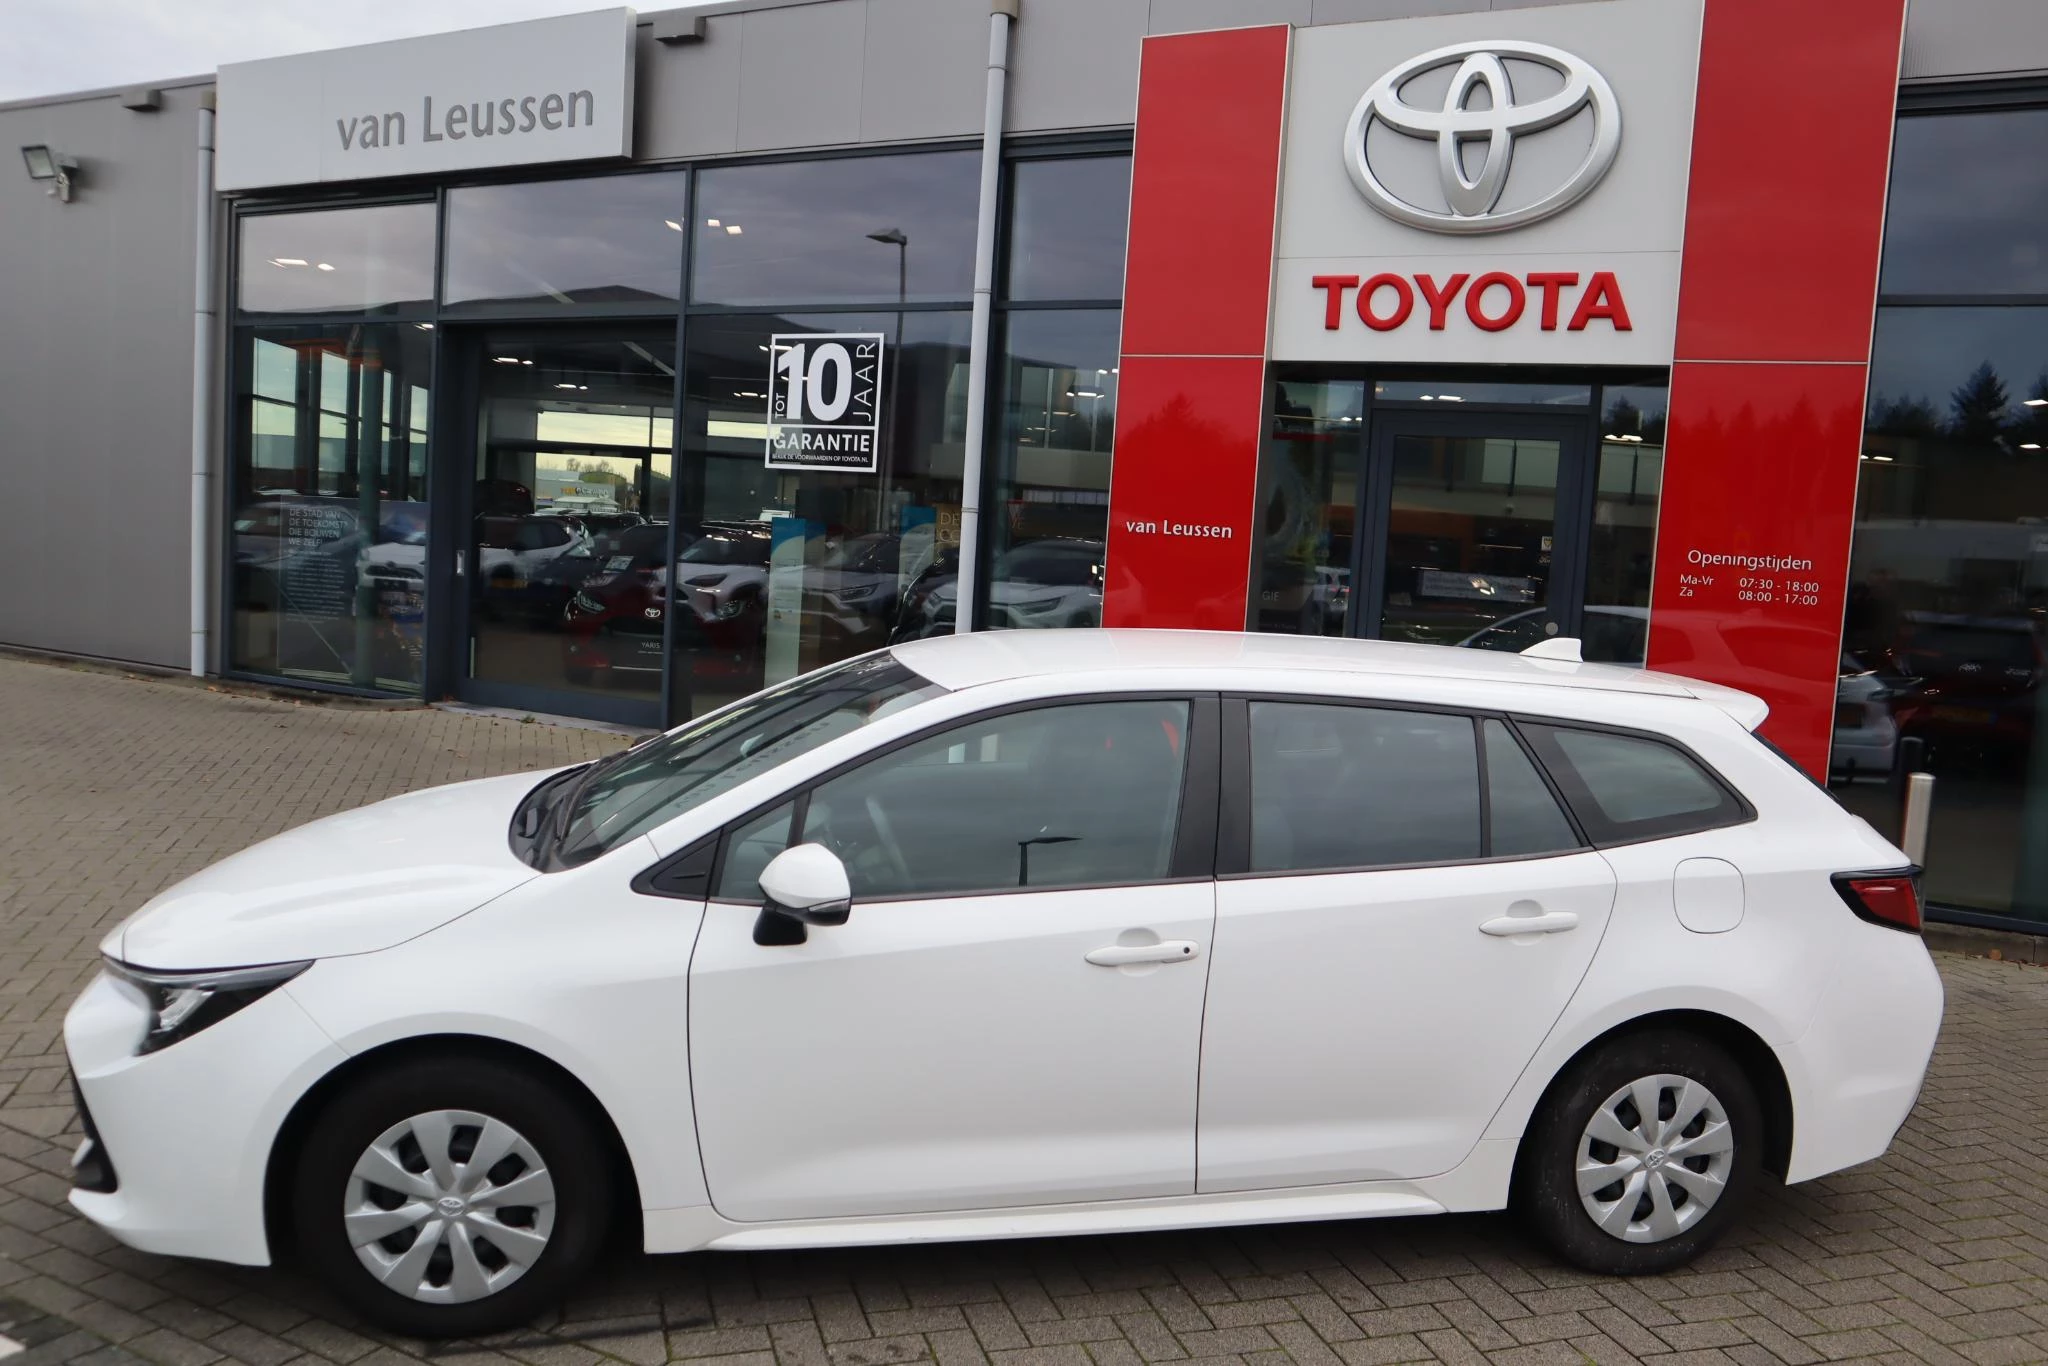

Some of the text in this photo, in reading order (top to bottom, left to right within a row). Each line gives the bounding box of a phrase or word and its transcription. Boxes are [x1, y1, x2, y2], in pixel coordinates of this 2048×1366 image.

[336, 88, 595, 151] van Leussen
[1311, 271, 1633, 332] TOYOTA
[777, 342, 853, 422] 10
[852, 342, 876, 422] JAAR
[774, 392, 786, 420] TOT
[772, 432, 870, 452] GARANTIE
[1126, 519, 1232, 539] van Leussen
[1687, 549, 1813, 572] Openingstijden
[1680, 574, 1714, 586] Ma-Vr
[1739, 577, 1774, 590] 07:30
[1786, 580, 1819, 593] 18:00
[1679, 587, 1693, 597] Za
[1738, 590, 1772, 602] 08:00
[1784, 593, 1818, 606] 17:00
